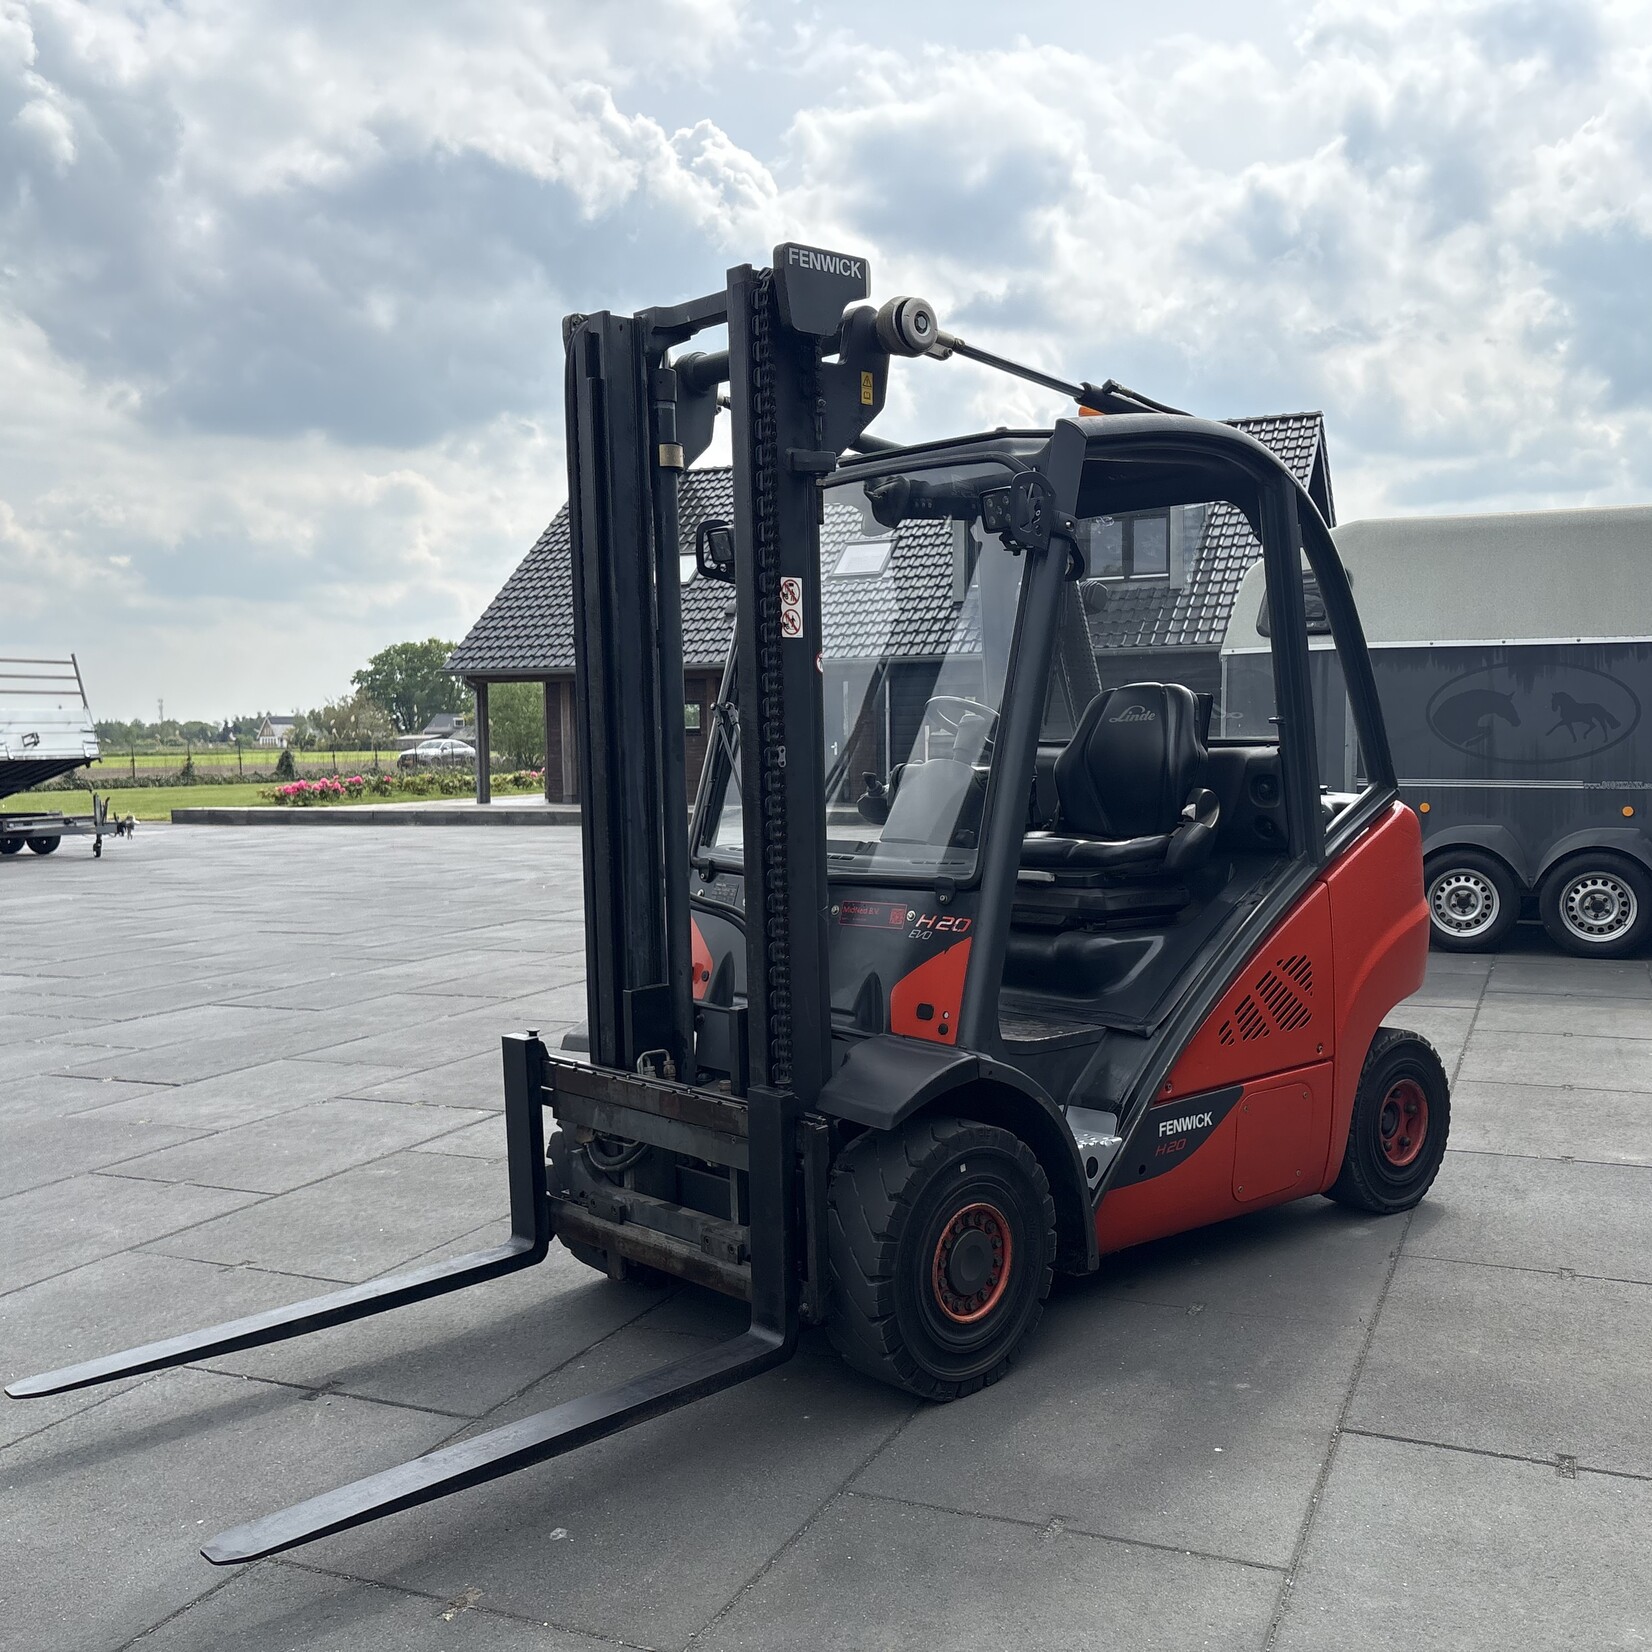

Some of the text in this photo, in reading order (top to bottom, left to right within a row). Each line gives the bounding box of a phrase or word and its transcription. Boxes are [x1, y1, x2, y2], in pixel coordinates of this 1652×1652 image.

[788, 246, 862, 279] FENWICK
[1109, 704, 1156, 723] Linde
[908, 929, 933, 940] EVO
[1159, 1111, 1213, 1138] FENWICK
